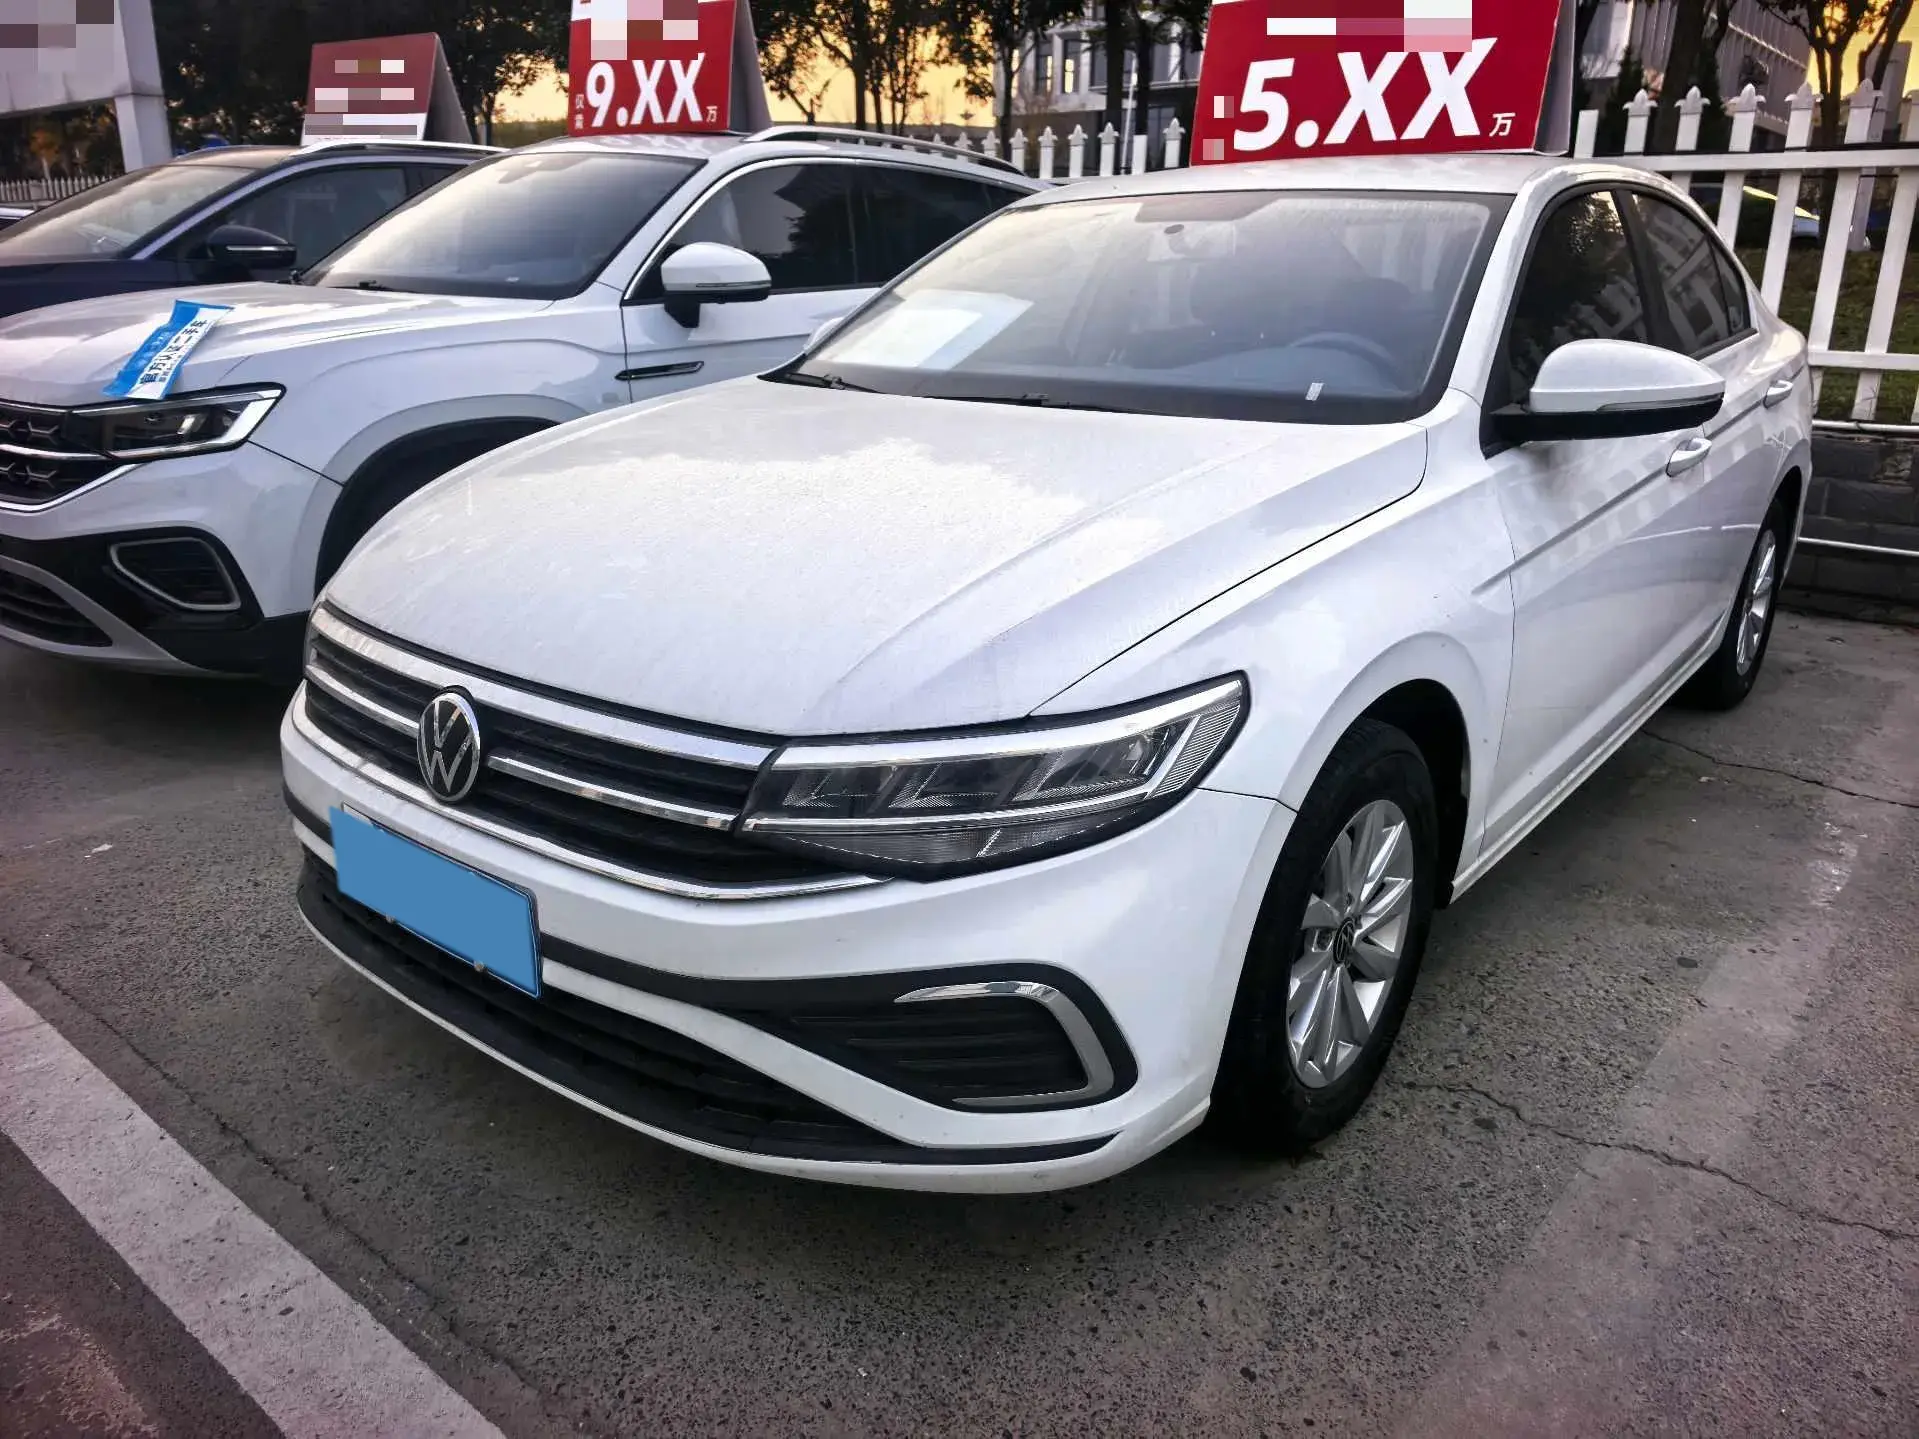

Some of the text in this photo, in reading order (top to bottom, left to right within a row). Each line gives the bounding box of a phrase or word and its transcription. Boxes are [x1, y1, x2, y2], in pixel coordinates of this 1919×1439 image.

[586, 53, 718, 127] 9.XX 万
[1233, 38, 1516, 151] 5.XX 万
